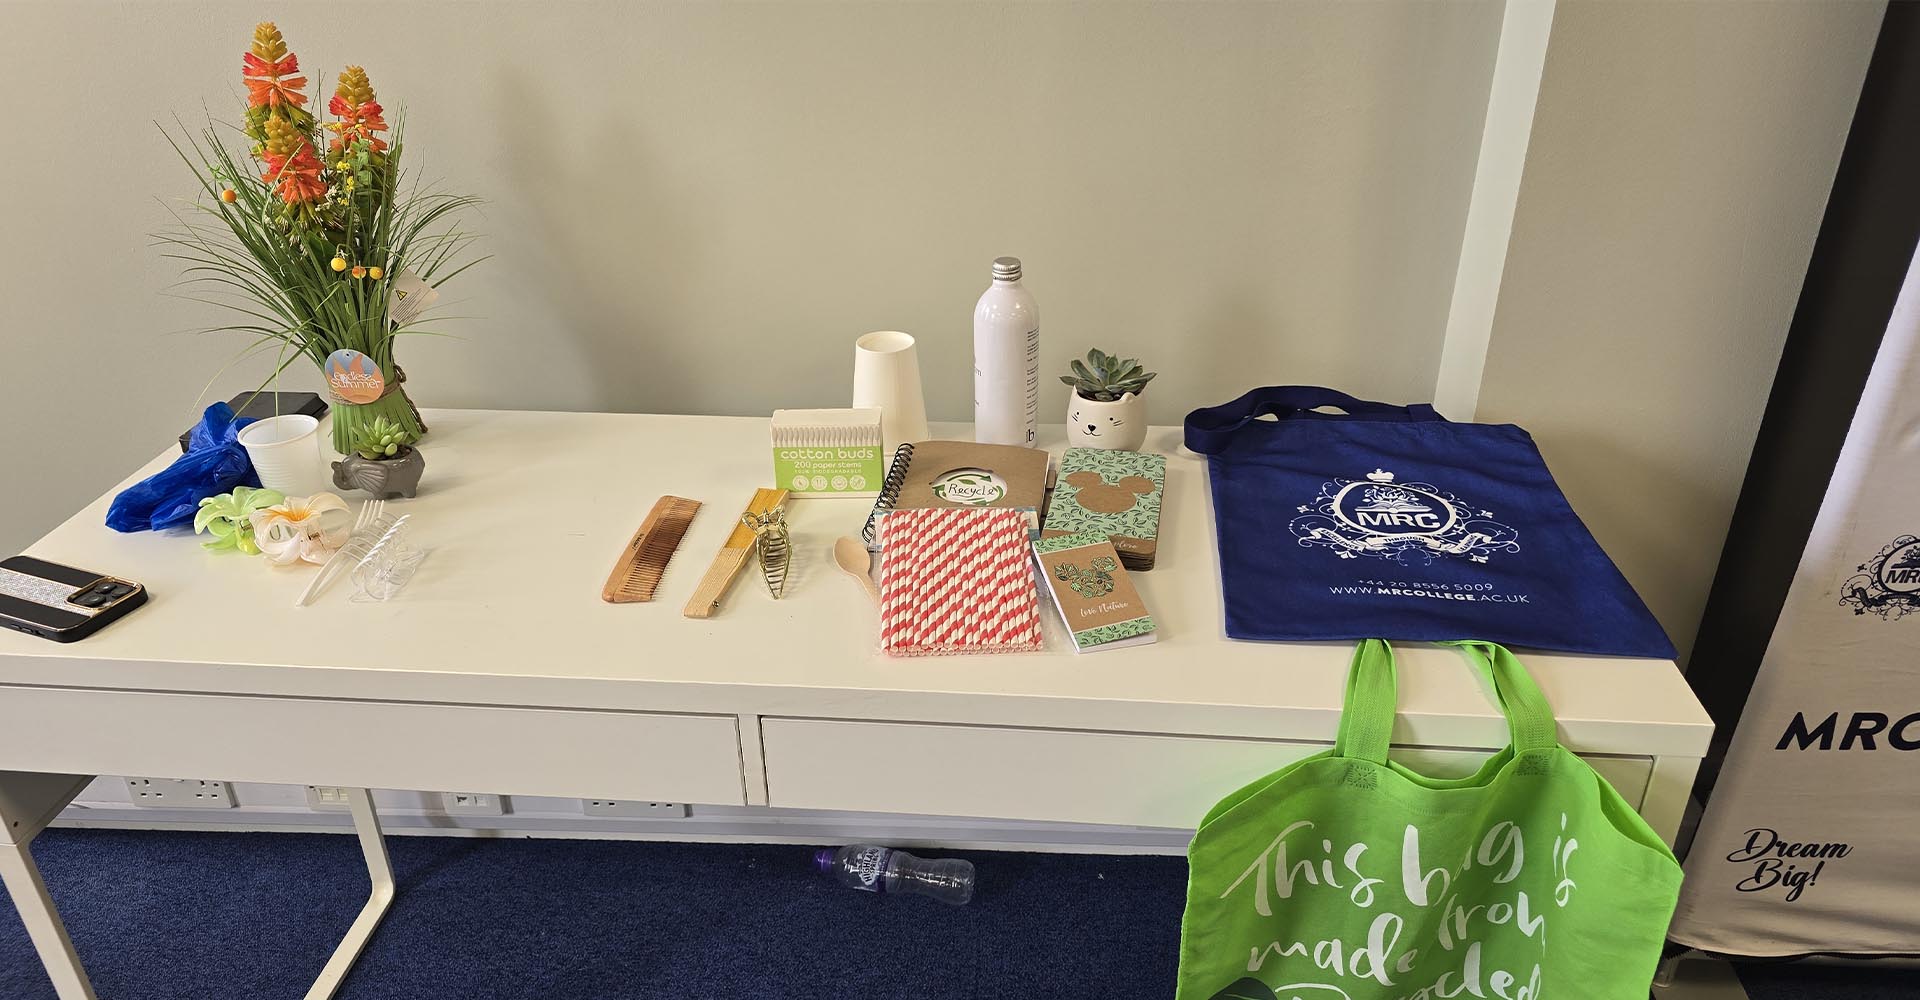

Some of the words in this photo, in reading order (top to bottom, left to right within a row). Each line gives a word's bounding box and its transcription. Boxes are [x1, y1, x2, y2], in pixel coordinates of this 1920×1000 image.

[781, 448, 834, 459] cotton
[837, 448, 874, 459] buds
[948, 483, 995, 498] Recycle
[1356, 511, 1441, 529] MRC
[1412, 582, 1449, 591] 8556
[1454, 583, 1493, 592] 5009
[1884, 569, 1920, 584] MR
[1329, 586, 1530, 604] WWW.MRCOLLEGE.AC.UK
[1774, 711, 1920, 751] MRC
[1726, 828, 1854, 862] Dream
[862, 848, 880, 883] HIGHLAND
[1220, 820, 1385, 917] This
[1553, 812, 1580, 908] is
[1736, 858, 1825, 902] Big!
[1246, 912, 1418, 987] made
